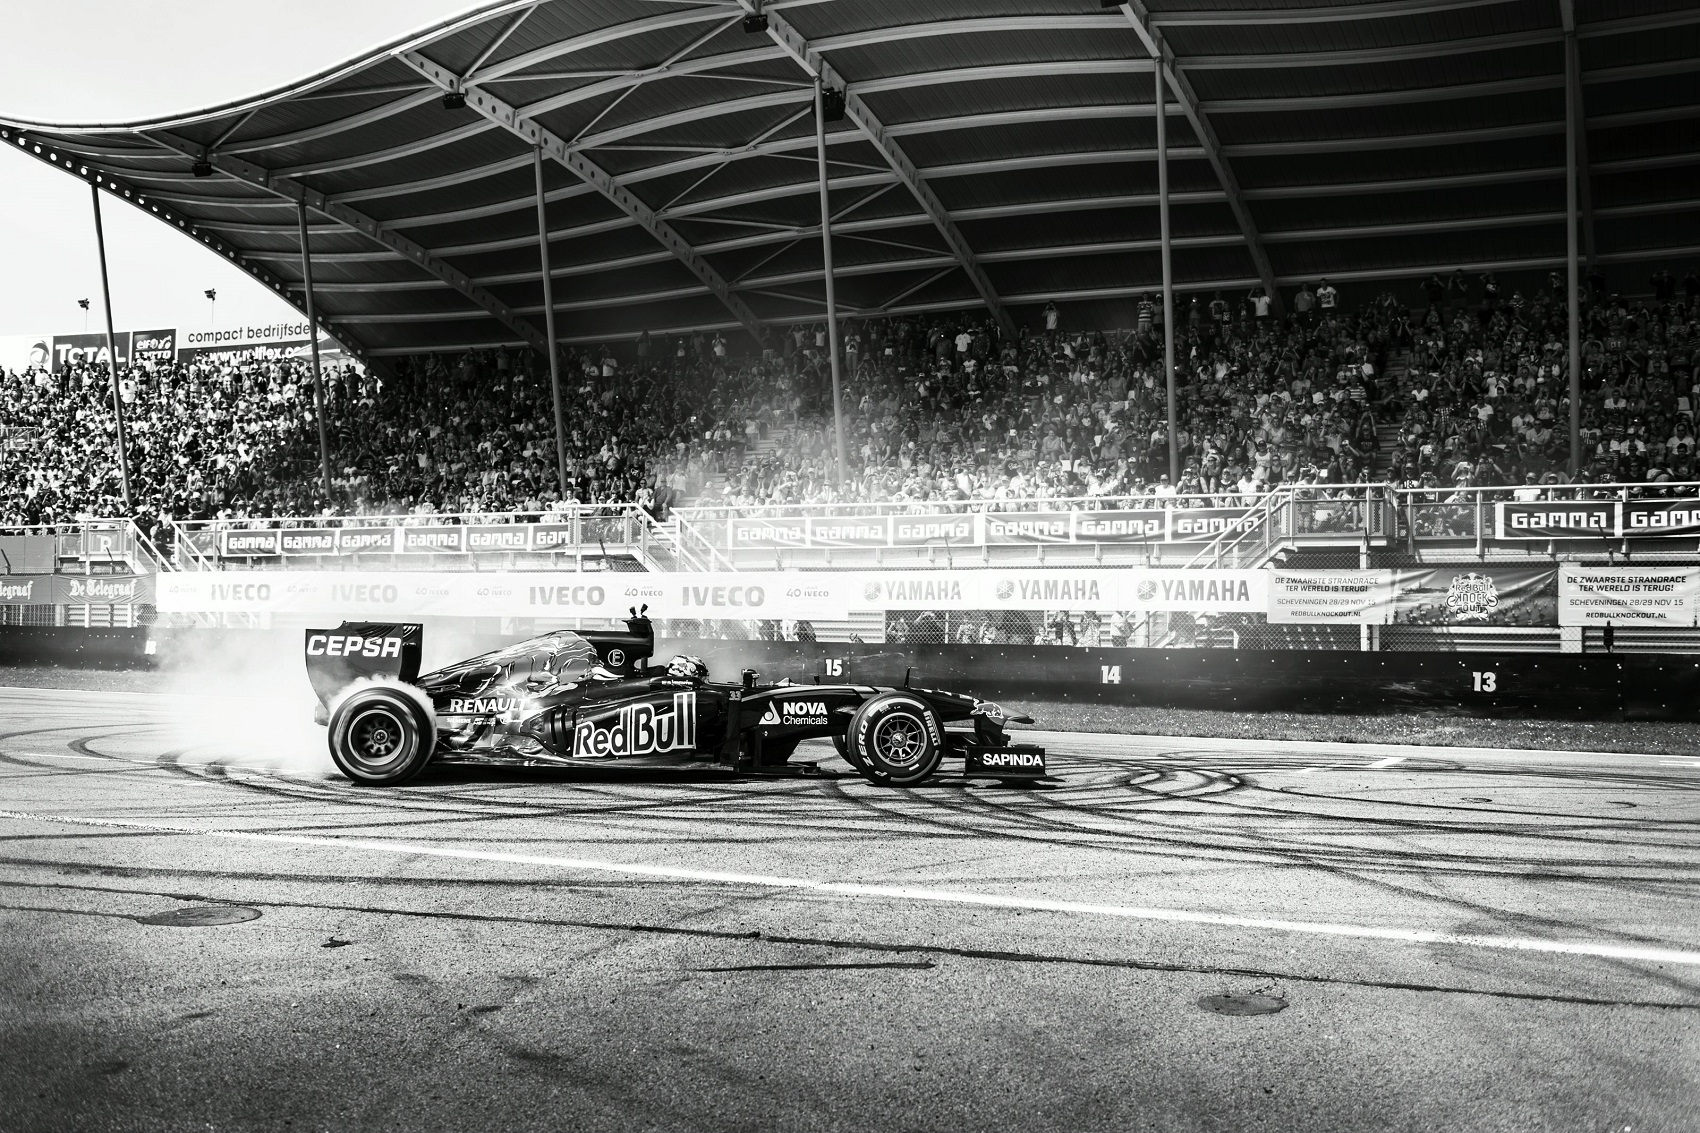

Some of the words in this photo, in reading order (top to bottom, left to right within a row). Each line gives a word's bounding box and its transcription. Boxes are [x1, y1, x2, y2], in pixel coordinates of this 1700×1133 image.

[188, 326, 243, 344] compact
[70, 580, 84, 596] De
[86, 579, 137, 600] Telegraaf
[211, 583, 272, 600] IVECO
[331, 584, 398, 603] IVECO
[477, 588, 490, 596] 40
[530, 586, 605, 605] IVECO
[624, 588, 638, 597] 40
[682, 586, 765, 606] IVECO
[786, 588, 801, 597] 40
[886, 580, 962, 600] YAMAHA
[1019, 580, 1100, 600] YAMAHA
[1161, 580, 1250, 601] YAMAHA
[307, 635, 402, 658] CEPSA
[825, 658, 843, 676] 15
[1101, 666, 1122, 684] 14
[1472, 672, 1497, 692] 13
[783, 702, 828, 715] NOVA
[783, 716, 828, 725] Chemicals
[858, 720, 874, 766] ZERO
[983, 753, 1044, 766] SAPINDA
